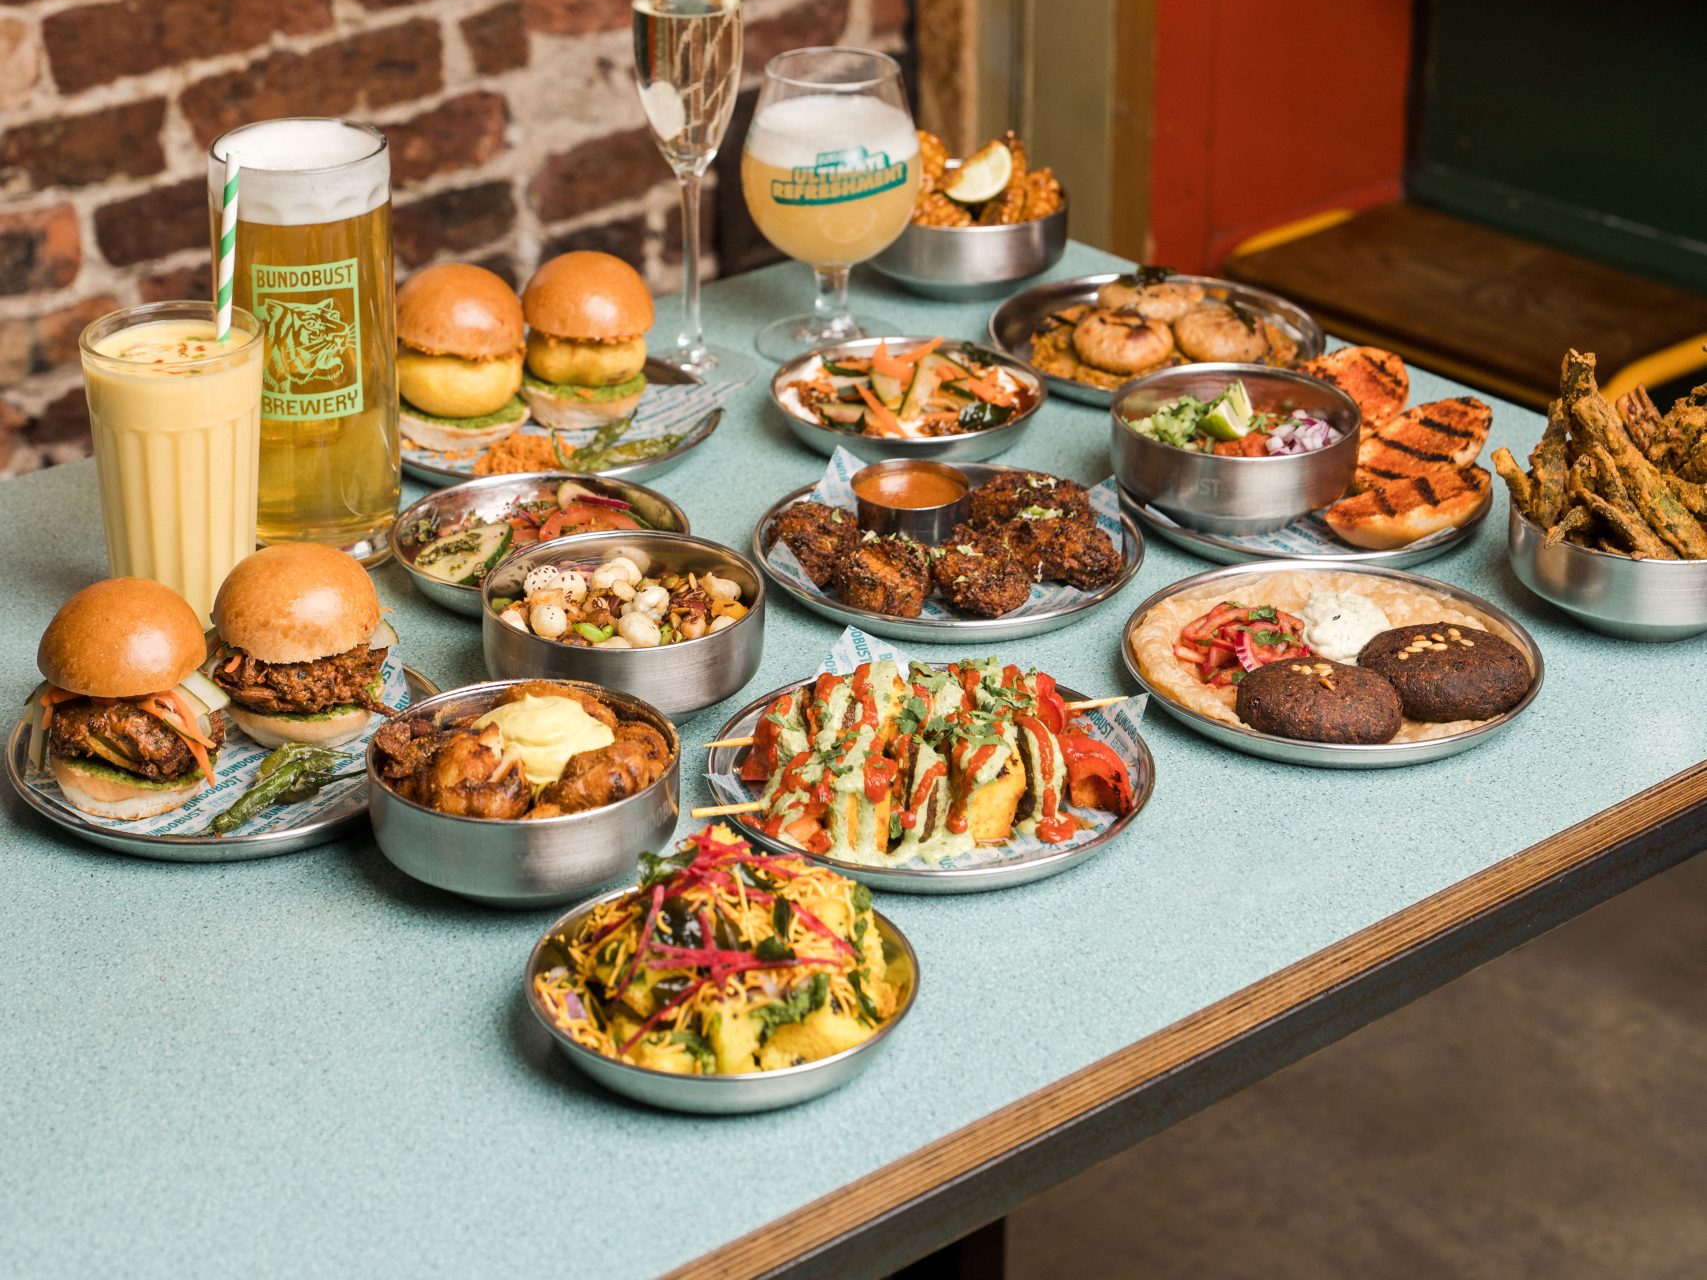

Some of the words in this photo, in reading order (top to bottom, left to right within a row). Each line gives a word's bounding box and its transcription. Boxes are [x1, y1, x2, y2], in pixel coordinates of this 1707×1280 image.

[256, 264, 354, 289] BUNDOBUST
[262, 389, 358, 417] BREWERY
[182, 775, 244, 812] BUNDOBUST
